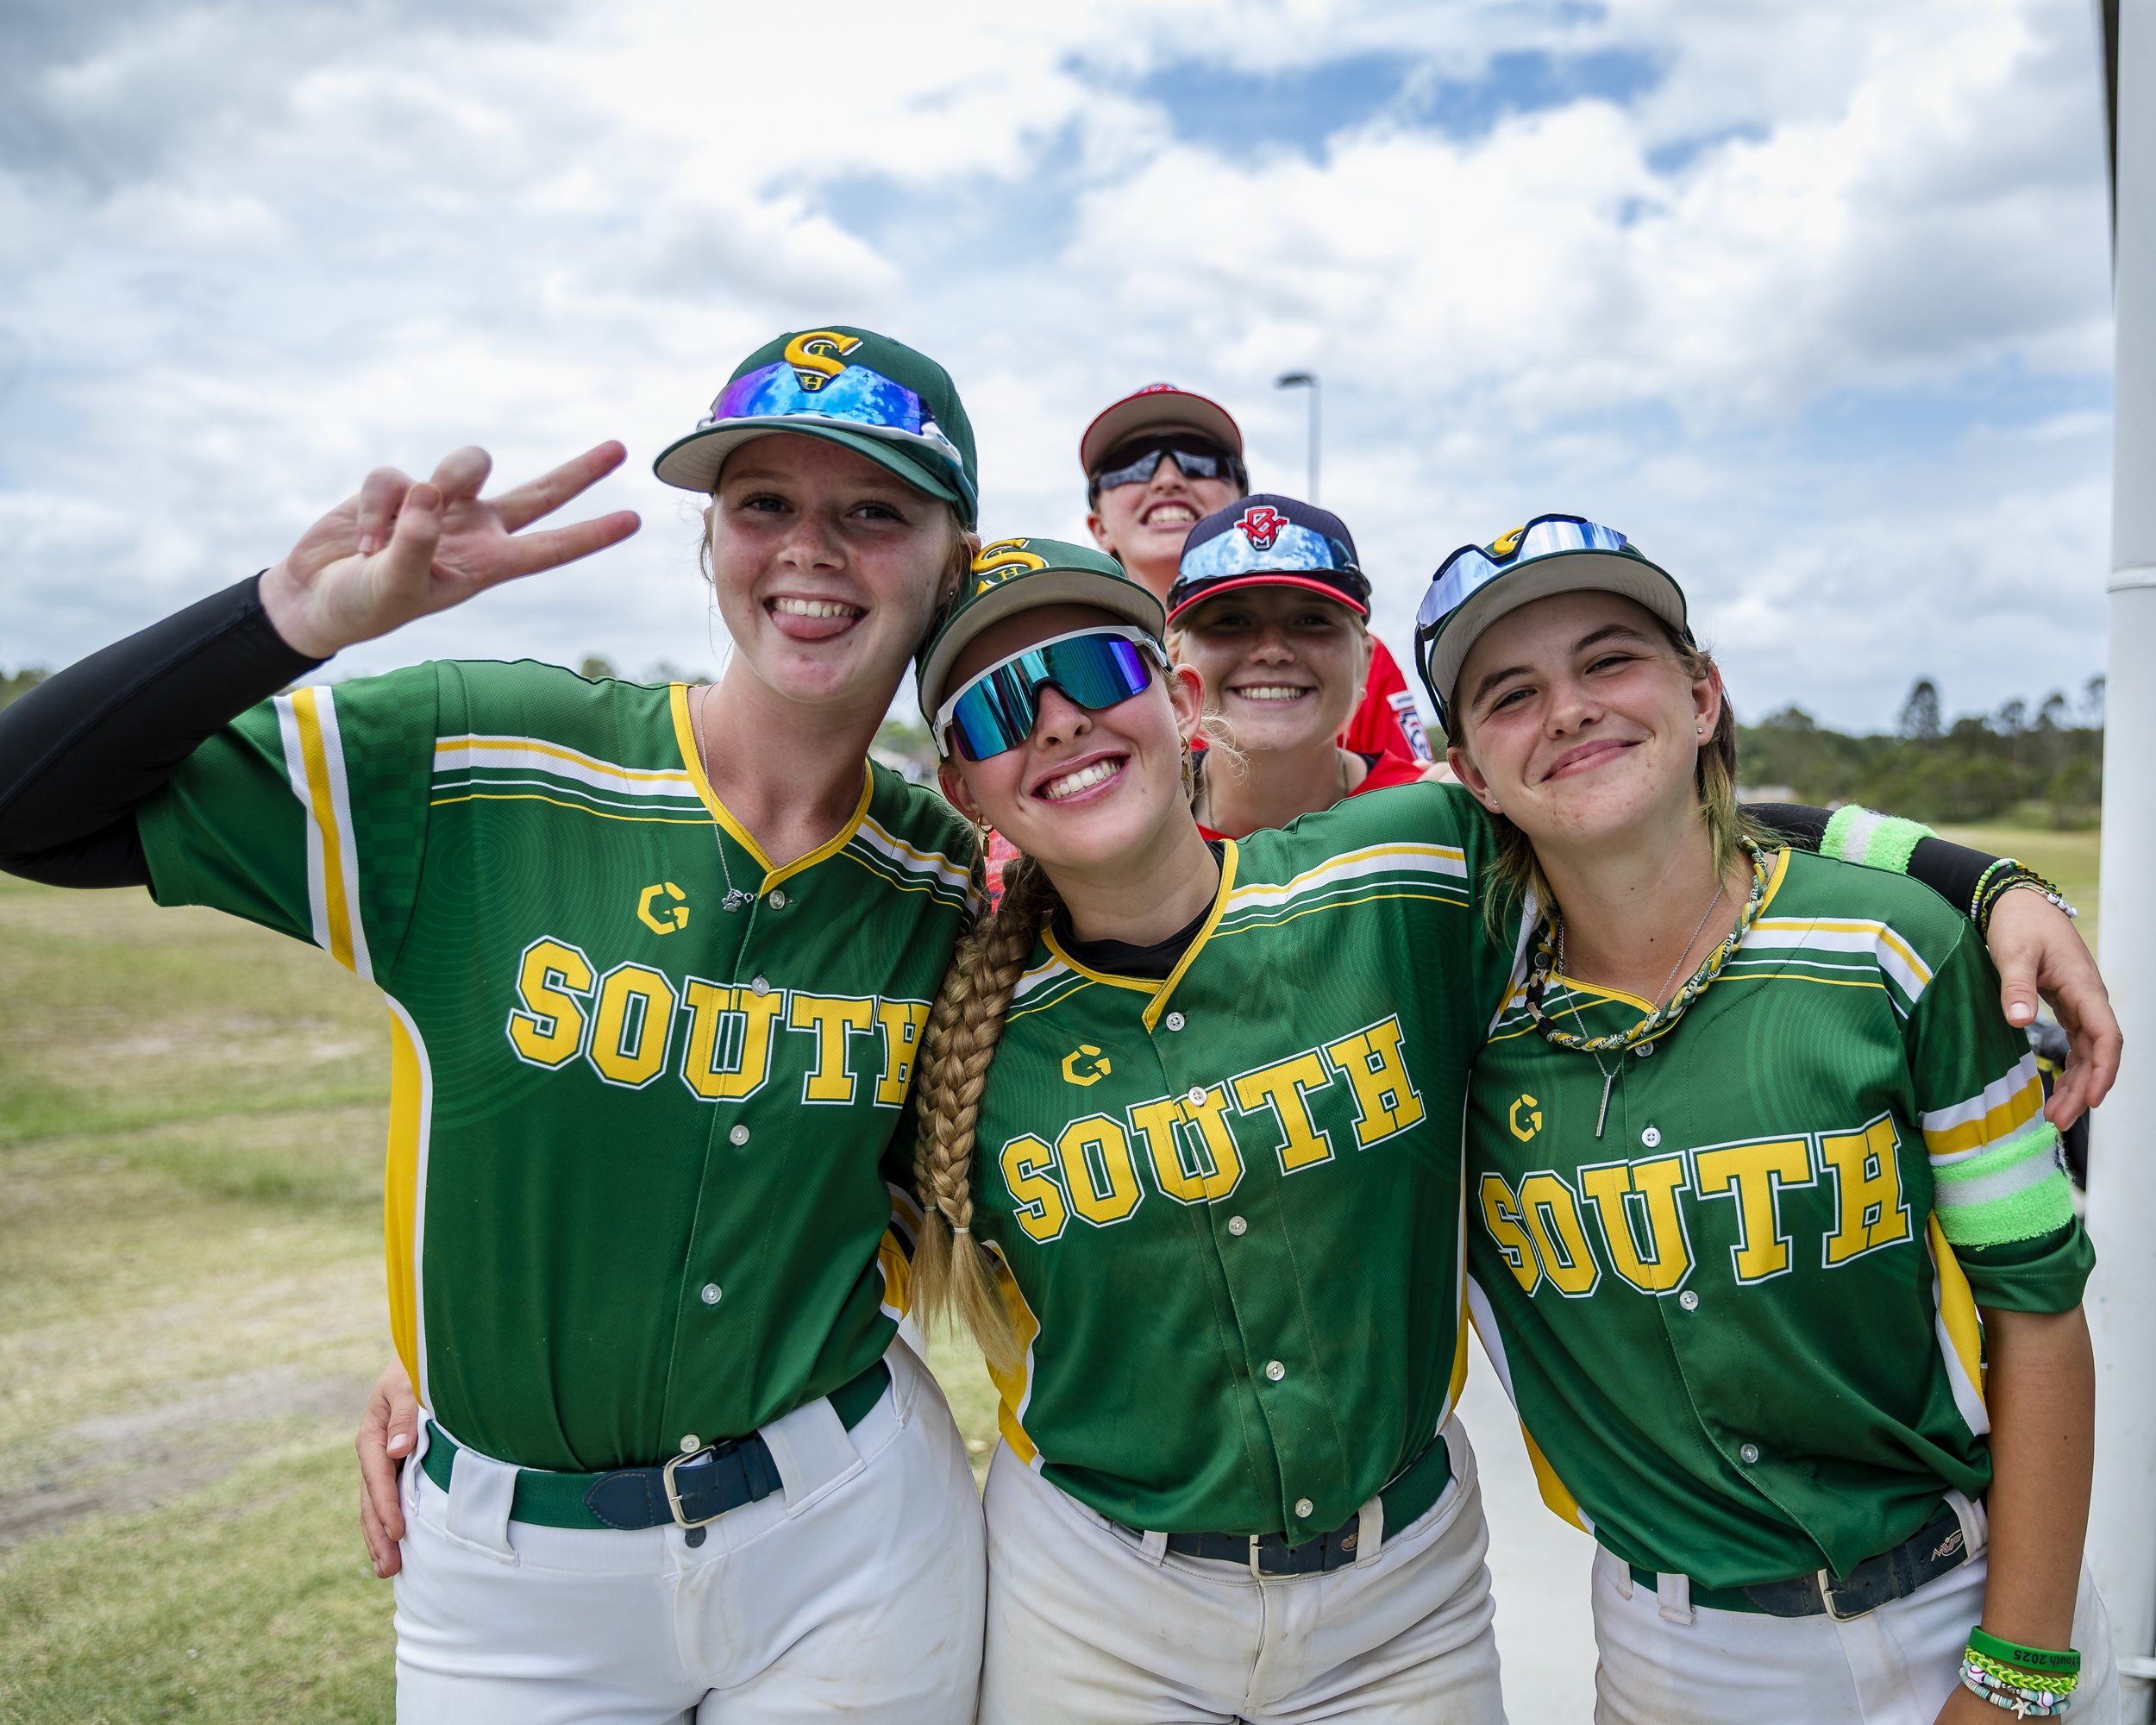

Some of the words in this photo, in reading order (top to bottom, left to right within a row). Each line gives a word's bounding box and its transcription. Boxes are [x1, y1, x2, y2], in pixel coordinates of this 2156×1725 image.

[506, 935, 932, 1108] SOUTH
[1000, 1013, 1426, 1244] SOUTH
[1478, 1110, 1913, 1298] SOUTH
[2013, 1649, 2047, 1665] 2025
[2049, 1655, 2077, 1667] Youth
